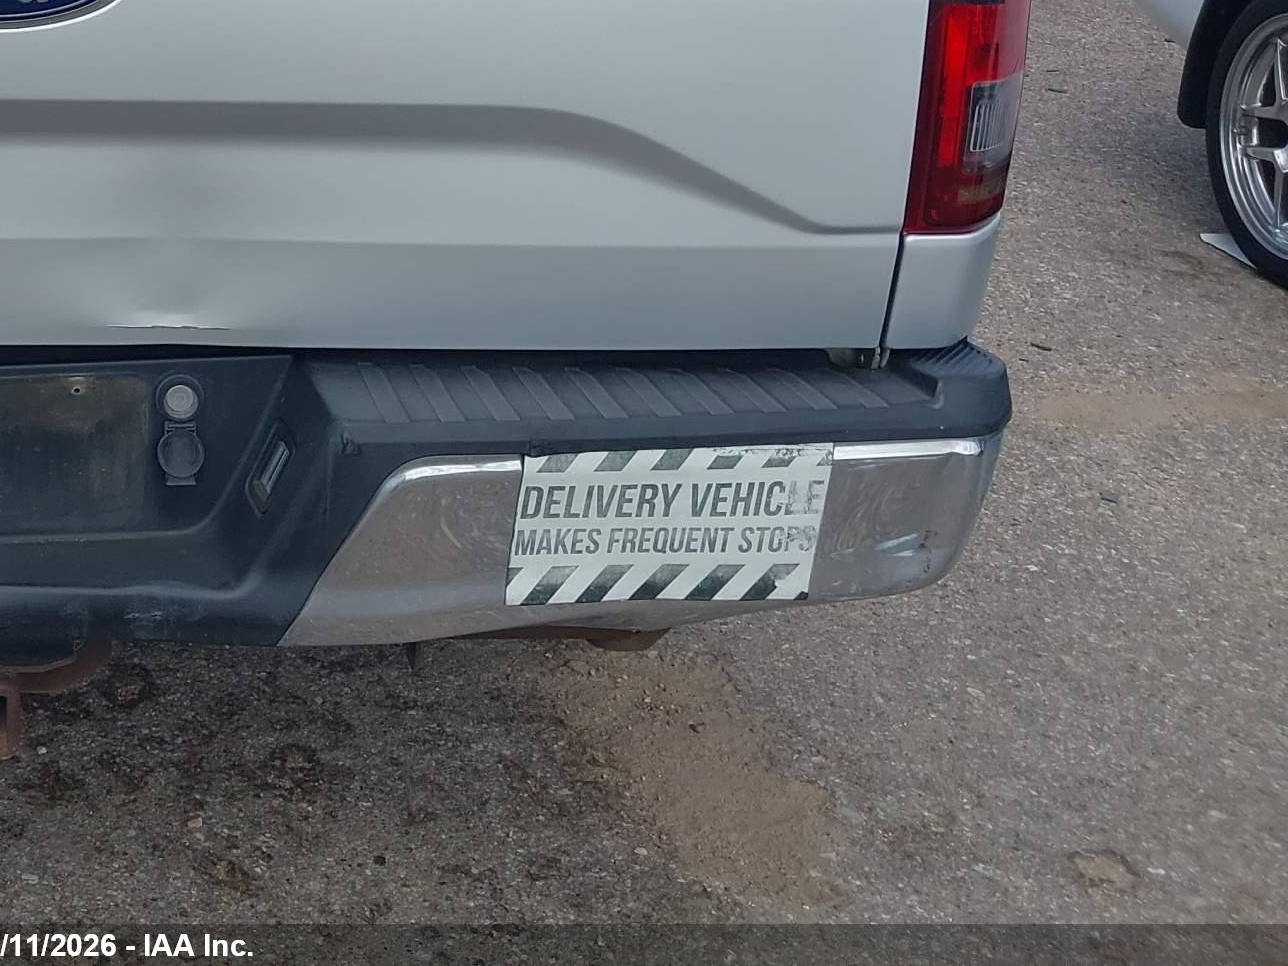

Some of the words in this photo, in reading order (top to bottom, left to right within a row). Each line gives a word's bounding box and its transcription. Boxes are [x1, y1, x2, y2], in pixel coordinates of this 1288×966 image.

[520, 482, 682, 520] DELIVERY
[514, 528, 602, 556] MAKES
[607, 526, 735, 554] FREQUENT
